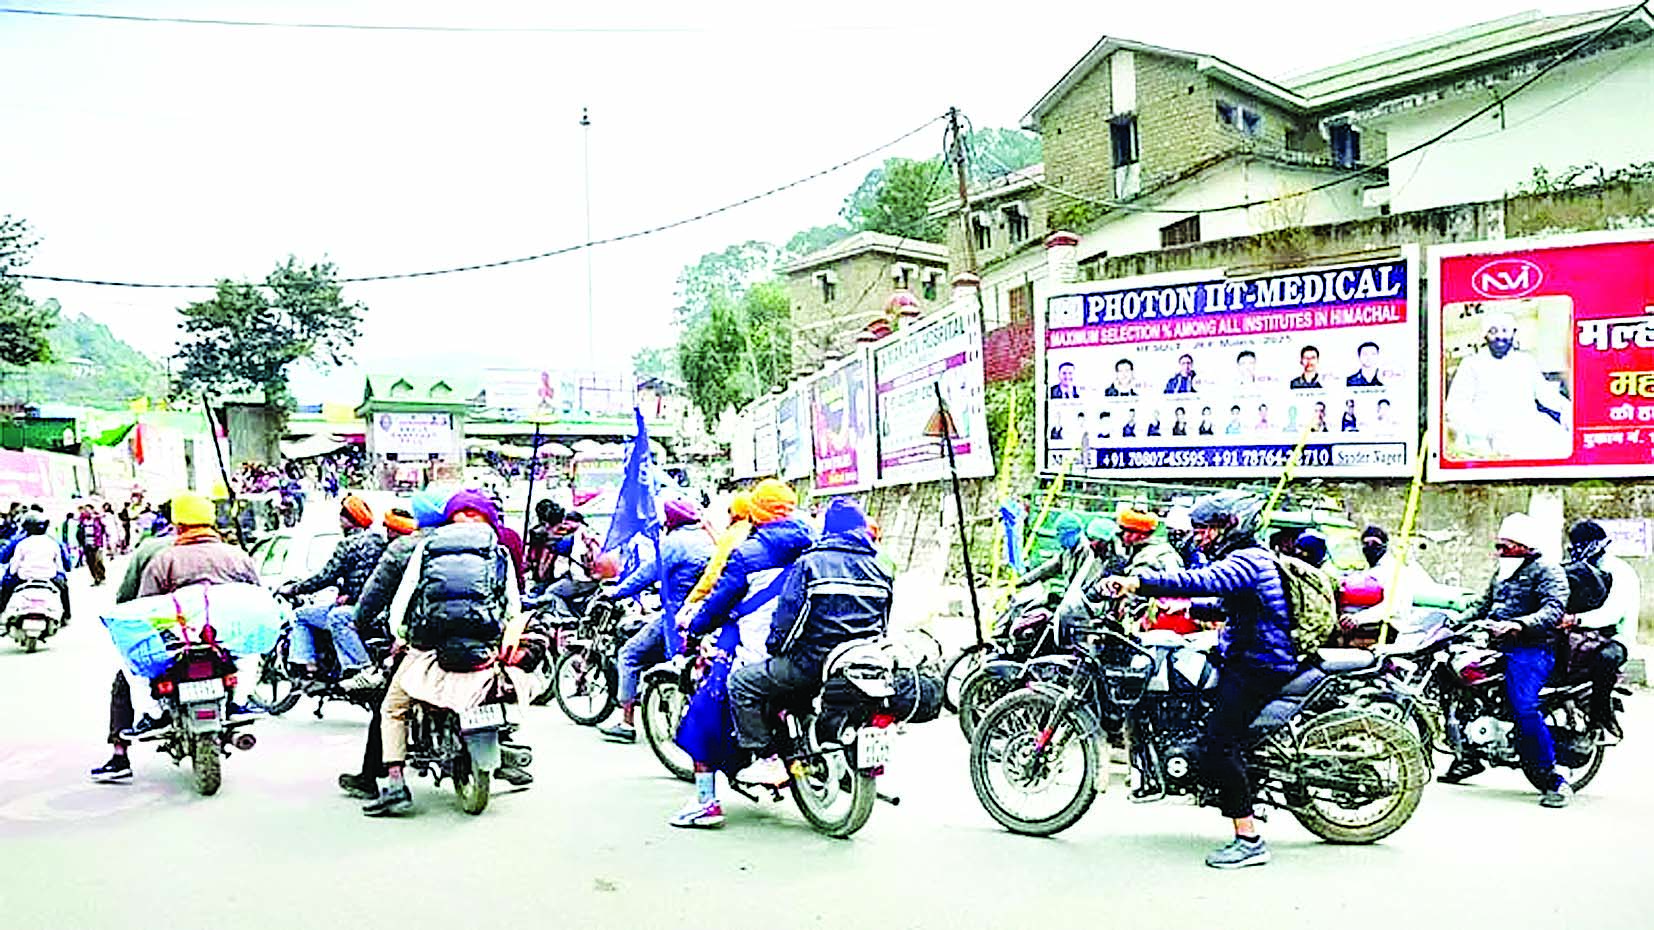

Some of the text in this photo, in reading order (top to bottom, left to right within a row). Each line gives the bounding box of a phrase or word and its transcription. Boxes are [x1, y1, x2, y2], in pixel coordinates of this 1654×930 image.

[1087, 265, 1401, 323] PHOTON IIT-MEDICAL
[1100, 323, 1160, 343] SELECTION
[1172, 319, 1216, 337] AMONG
[1217, 317, 1241, 334] ALL
[1242, 310, 1312, 331] INSTITUTES
[1314, 308, 1329, 327] IN
[1330, 304, 1400, 325] HIMACHAL
[1103, 452, 1125, 468] +91
[1212, 449, 1238, 467] +91
